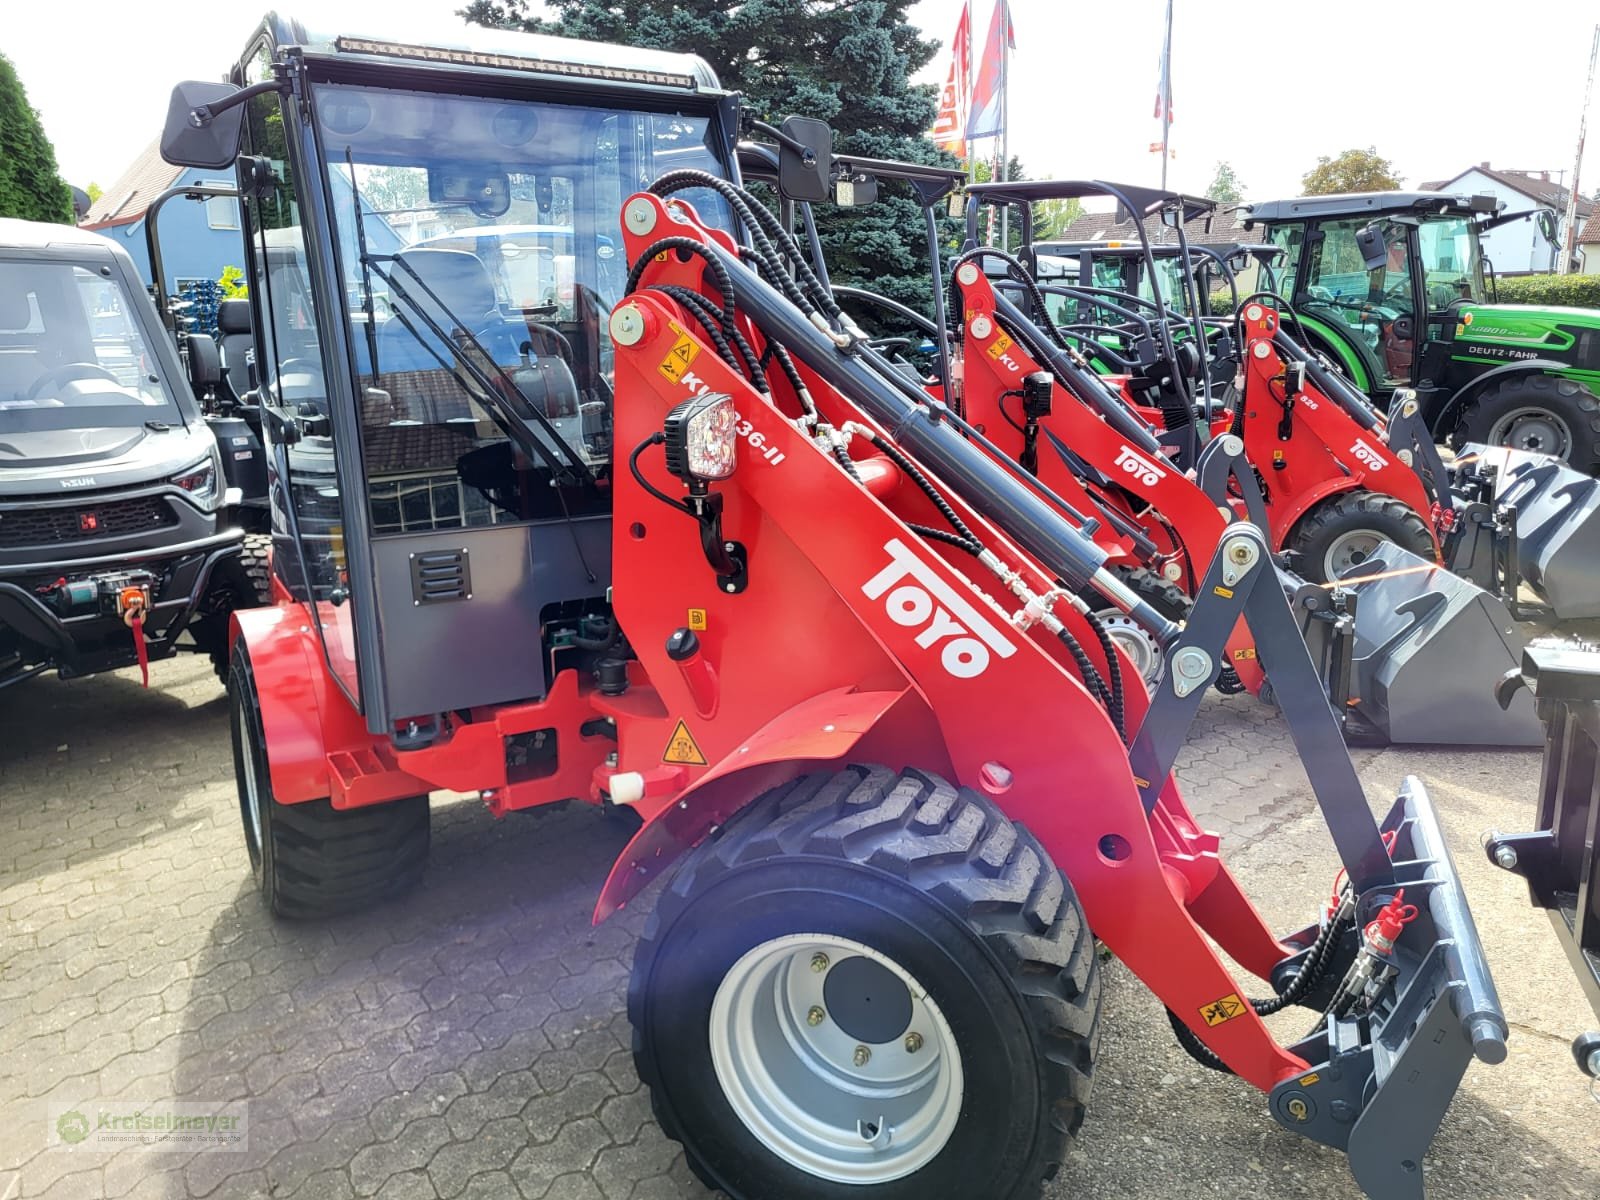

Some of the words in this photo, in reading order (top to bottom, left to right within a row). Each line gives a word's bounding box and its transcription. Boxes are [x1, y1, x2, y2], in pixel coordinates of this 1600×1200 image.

[999, 353, 1020, 371] KU
[1300, 395, 1319, 410] 826
[733, 410, 786, 466] 36-II
[1349, 438, 1389, 472] TOYO
[1113, 444, 1167, 487] TOYO
[861, 538, 1018, 679] TOYO
